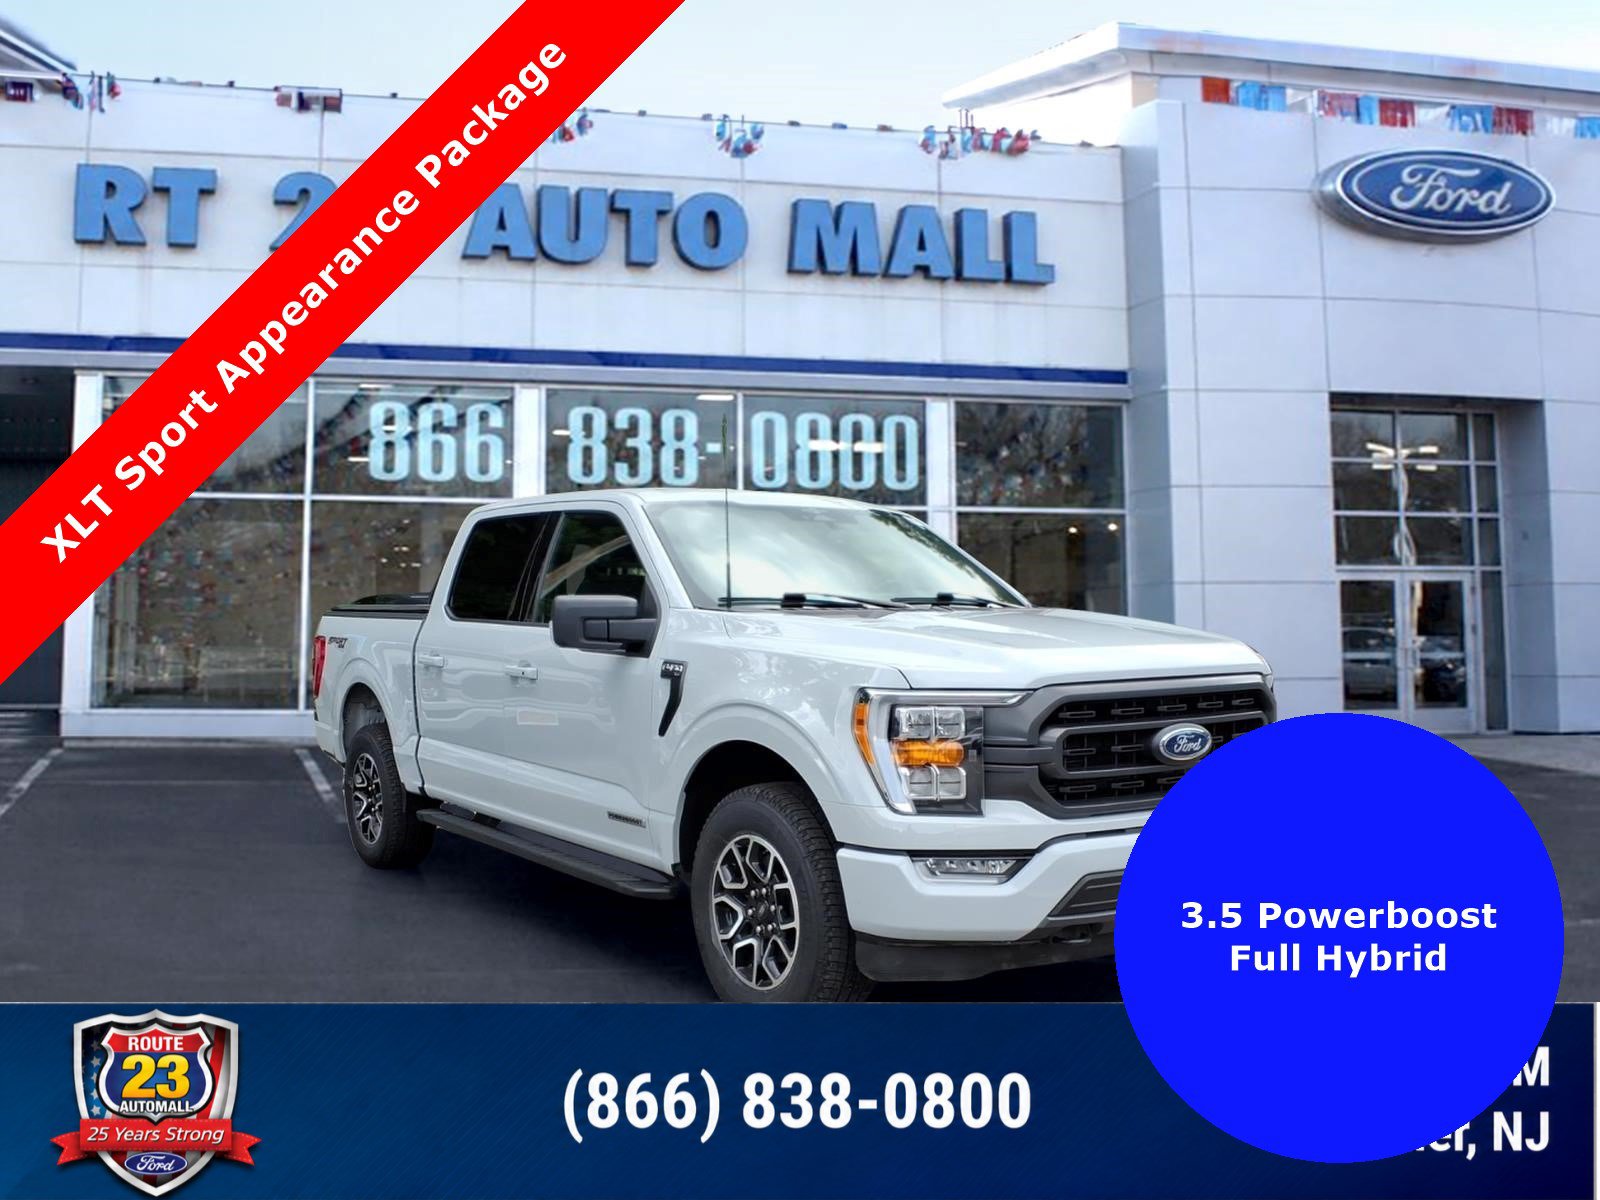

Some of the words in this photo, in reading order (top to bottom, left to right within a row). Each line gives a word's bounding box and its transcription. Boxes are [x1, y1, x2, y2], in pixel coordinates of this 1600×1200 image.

[74, 163, 218, 248] RT
[461, 182, 749, 271] AUTO
[787, 198, 1056, 286] MALL
[1390, 163, 1512, 215] Ford
[369, 401, 505, 482] 866
[751, 410, 920, 491] 0800
[1174, 734, 1202, 753] Ford
